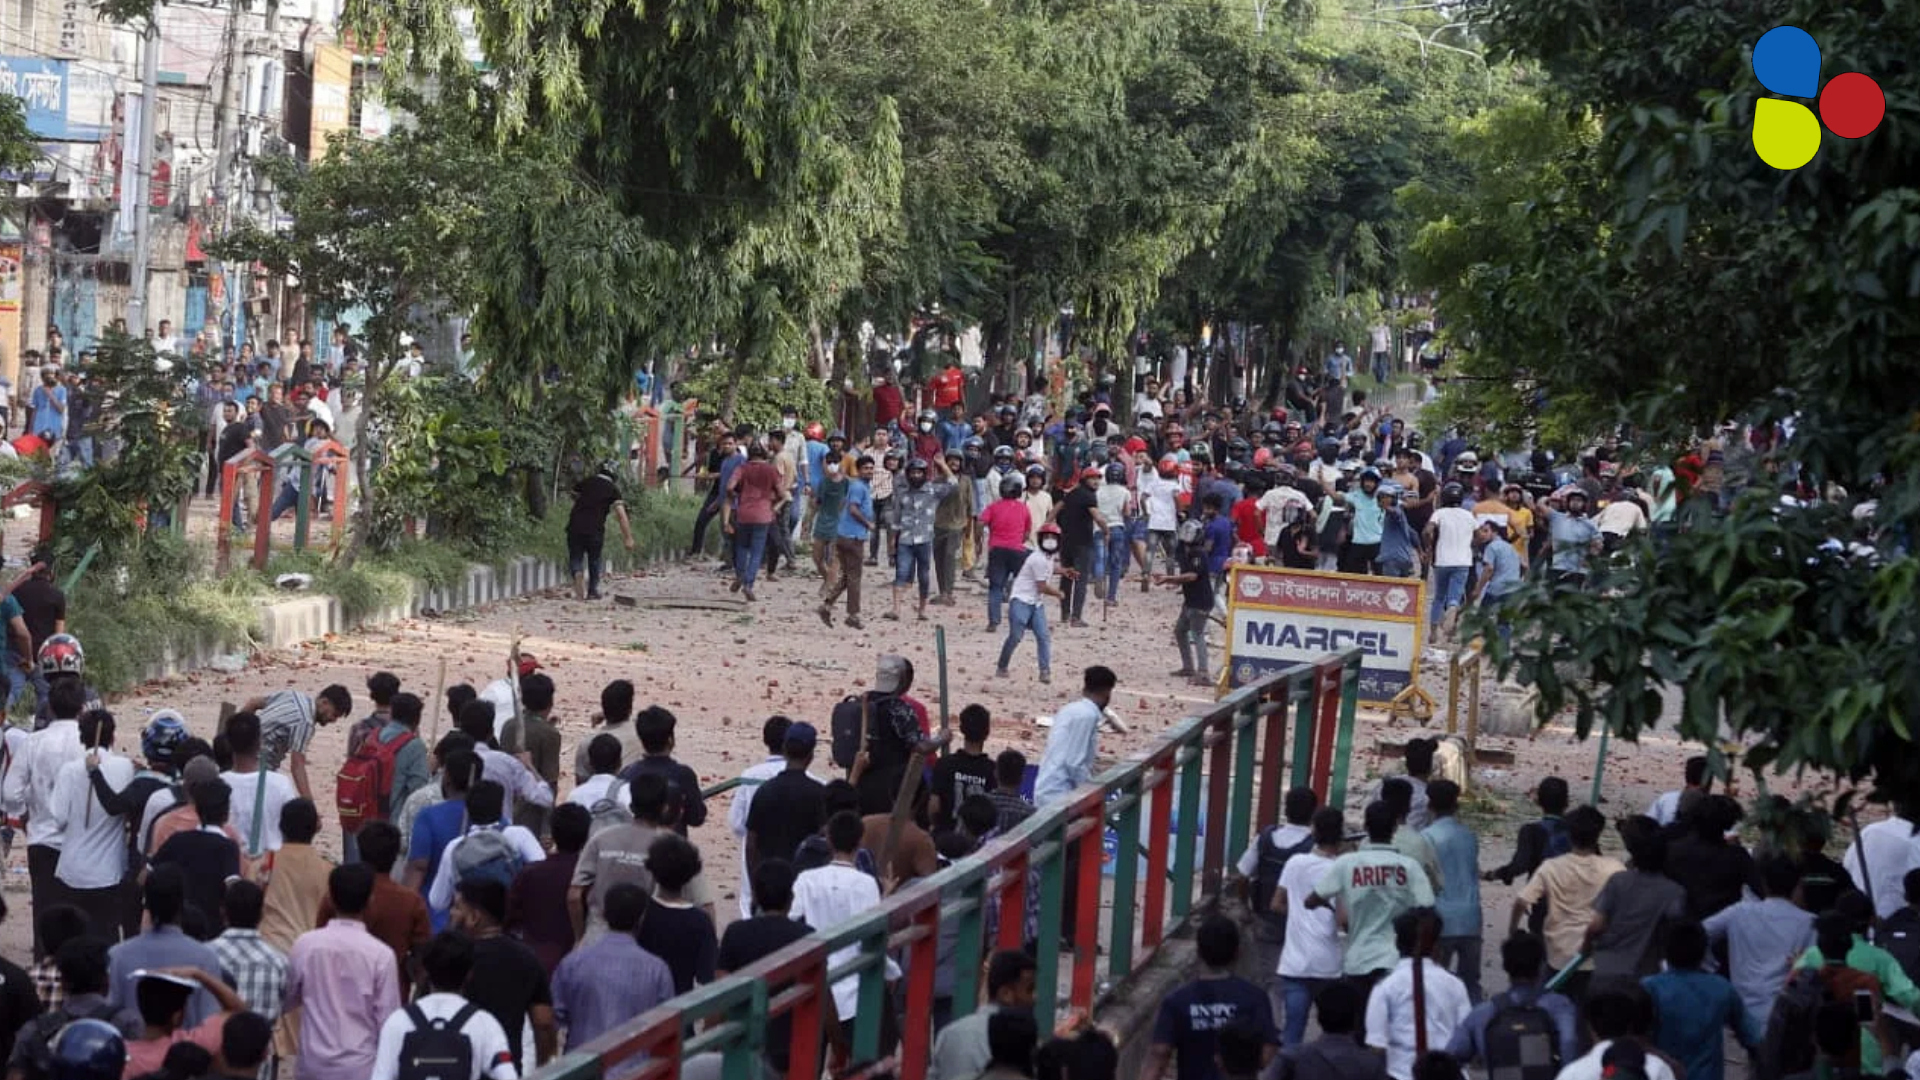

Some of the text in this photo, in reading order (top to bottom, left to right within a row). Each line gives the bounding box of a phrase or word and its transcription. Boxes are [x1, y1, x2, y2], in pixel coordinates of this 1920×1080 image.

[1268, 579, 1340, 604] ডাইভারশন
[1344, 585, 1385, 608] চলছে
[1246, 620, 1398, 657] MARCEL
[954, 771, 987, 787] BATCH
[1351, 864, 1408, 888] ARIF'S
